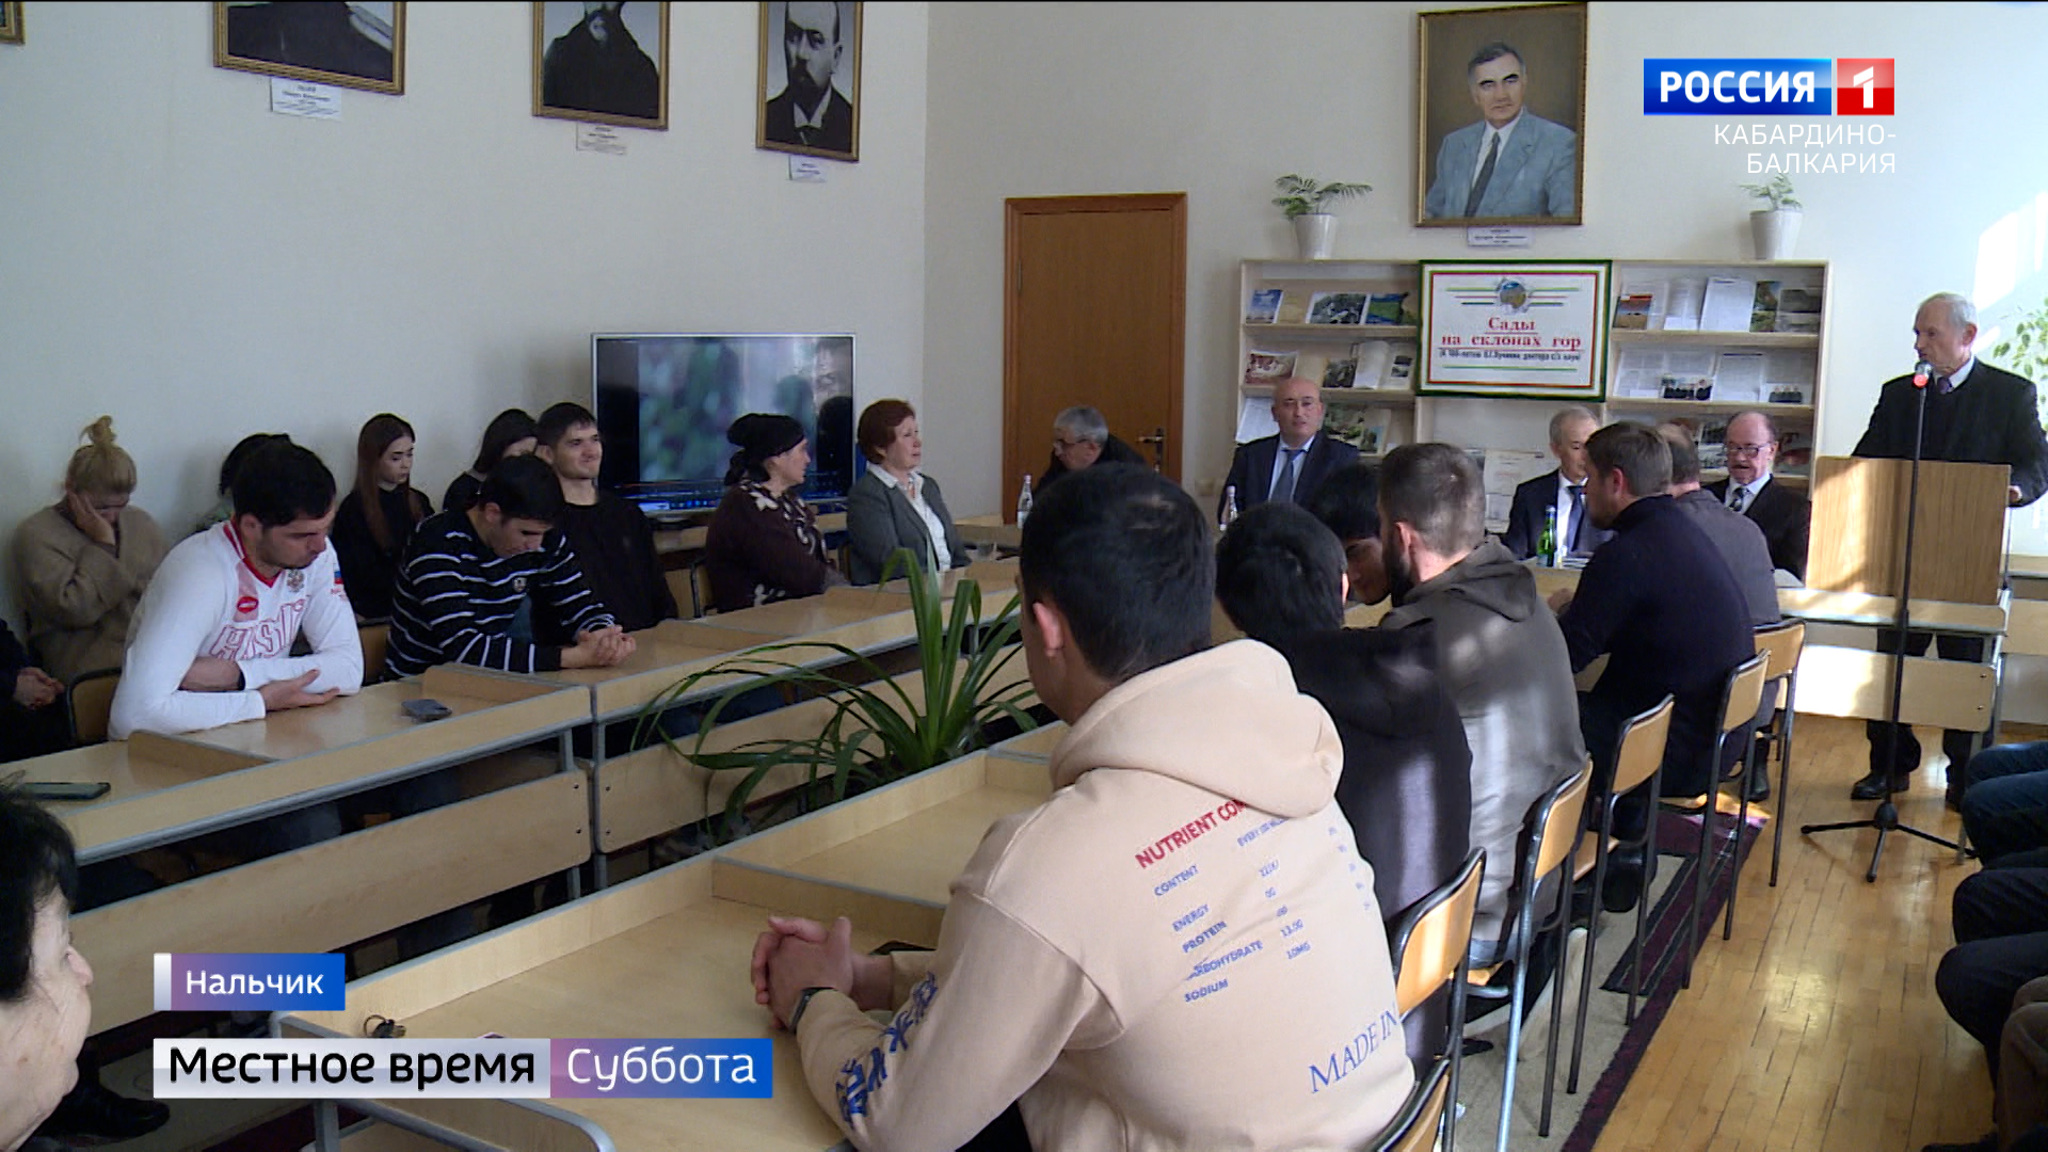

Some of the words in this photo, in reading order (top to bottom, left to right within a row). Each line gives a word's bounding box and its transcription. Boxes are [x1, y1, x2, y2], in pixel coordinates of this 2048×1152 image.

[1488, 317, 1536, 331] Сады
[1441, 335, 1461, 346] на
[1470, 336, 1542, 347] склонах
[1552, 338, 1581, 350] гор
[1134, 811, 1218, 869] NUTRIENT
[1154, 864, 1199, 896] CONTENT
[1172, 903, 1210, 932] ENERGY
[1182, 920, 1228, 954] PROTEIN
[1184, 978, 1229, 1002] SODIUM
[1308, 1022, 1380, 1094] MADE
